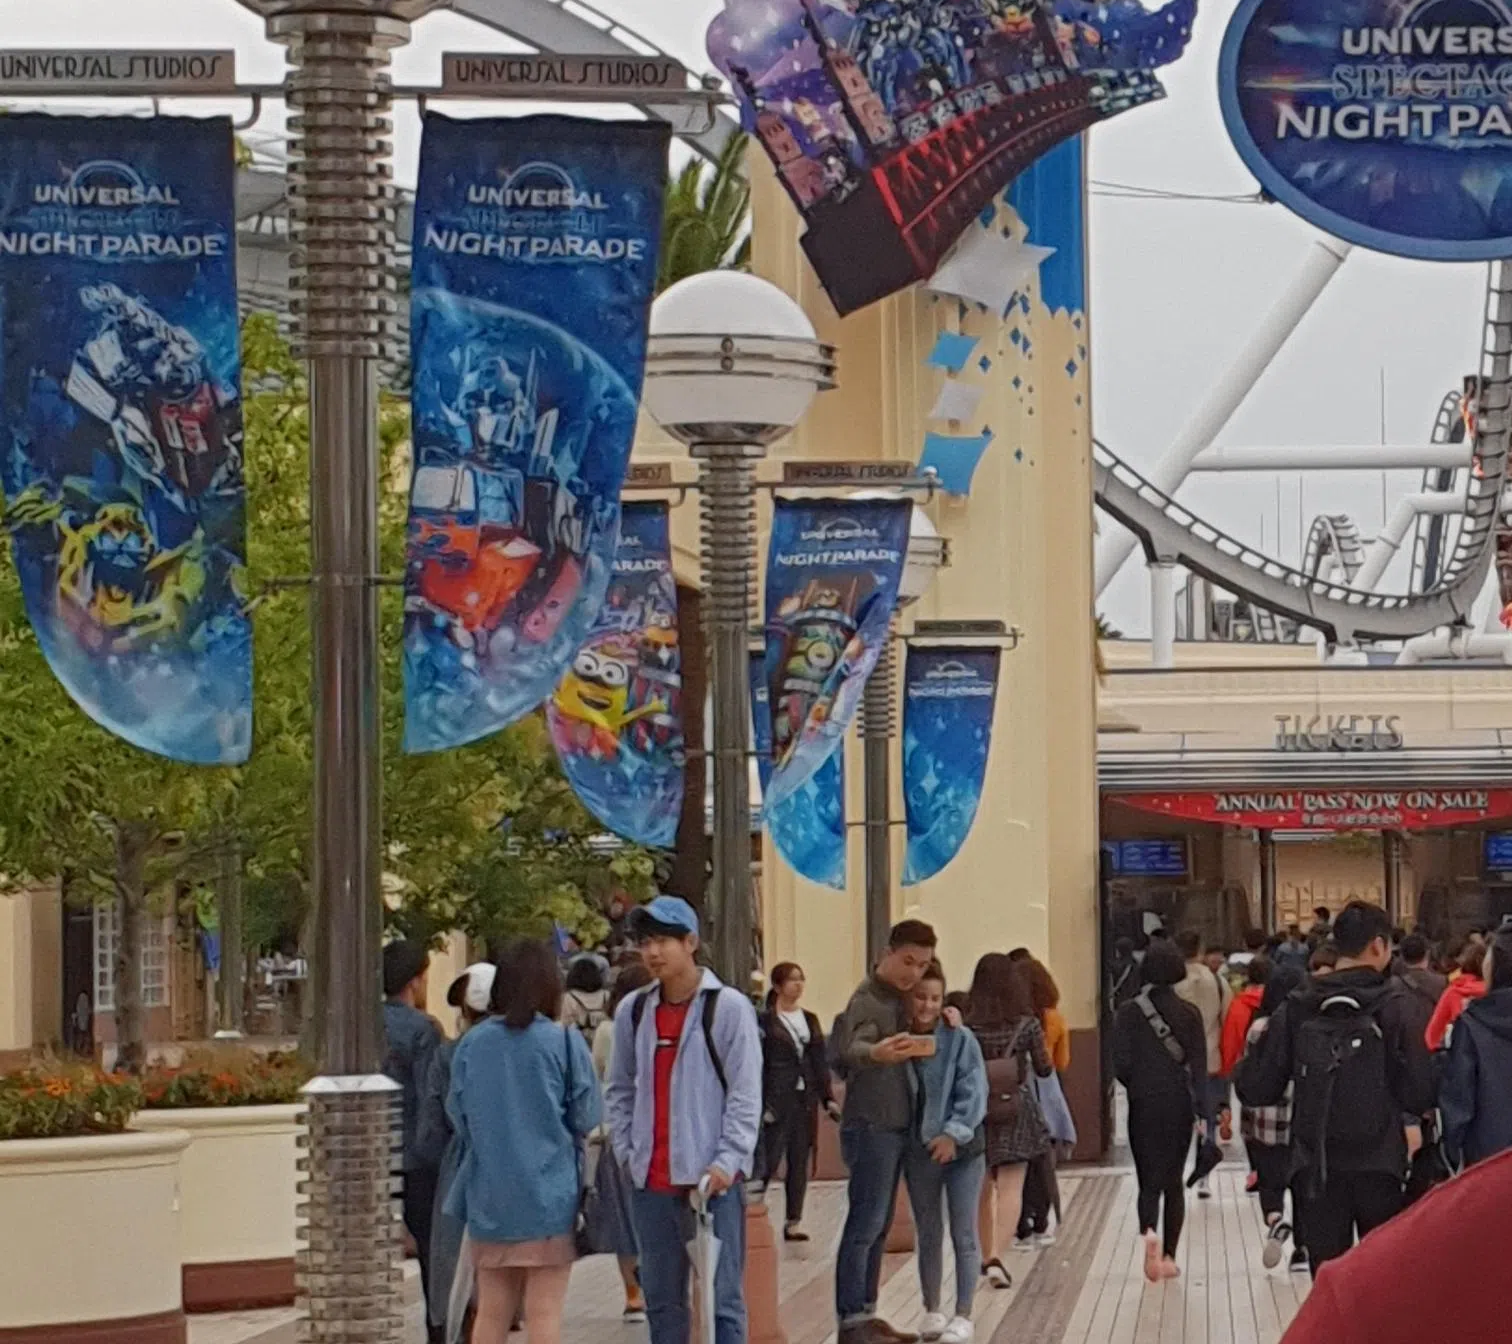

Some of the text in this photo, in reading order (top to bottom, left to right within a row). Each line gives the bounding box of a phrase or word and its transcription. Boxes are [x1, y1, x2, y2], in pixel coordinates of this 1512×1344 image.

[1, 56, 222, 80] UNIVERSAL STUDIOS
[456, 60, 671, 86] UNIVERSAL STUDIOS
[1276, 103, 1444, 139] NIGHT
[34, 184, 180, 205] UNIVERSAL
[467, 184, 608, 210] UNIVERSAL
[0, 232, 226, 257] NIGHT PARADE
[423, 224, 648, 261] NIGHT PARADE
[1275, 714, 1403, 751] TICKETS
[1215, 791, 1488, 812] ANNUAL PASS NOW ON SALE
